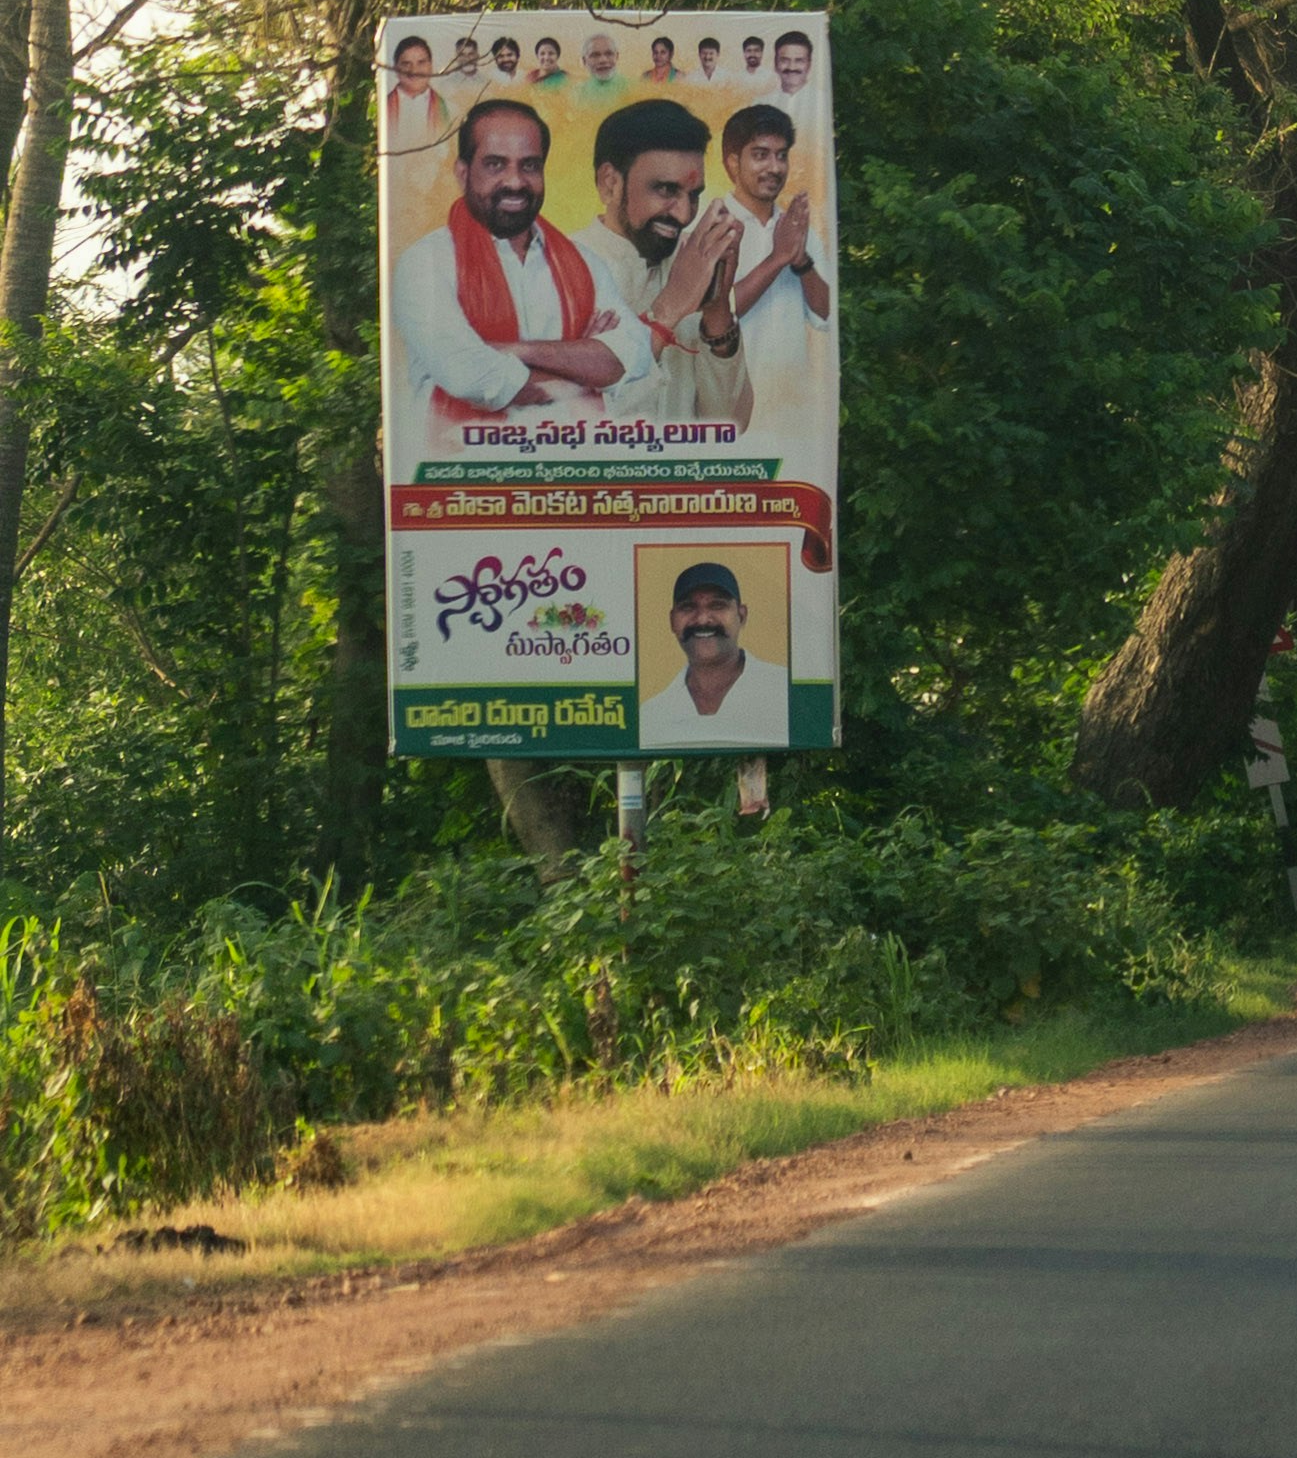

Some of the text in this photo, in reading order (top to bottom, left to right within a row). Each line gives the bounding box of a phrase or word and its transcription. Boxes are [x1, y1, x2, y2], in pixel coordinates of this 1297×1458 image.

[462, 420, 736, 453] రాజ్యసభ సభ్యులుగా
[446, 491, 506, 516] పాకా
[512, 491, 587, 516] వెంకట
[593, 489, 757, 522] సత్యనారాయణ
[434, 547, 587, 643] స్వాగతం
[505, 631, 631, 665] సుస్వాగతం
[406, 693, 626, 738] దాసరి దుర్గా రమేష్
